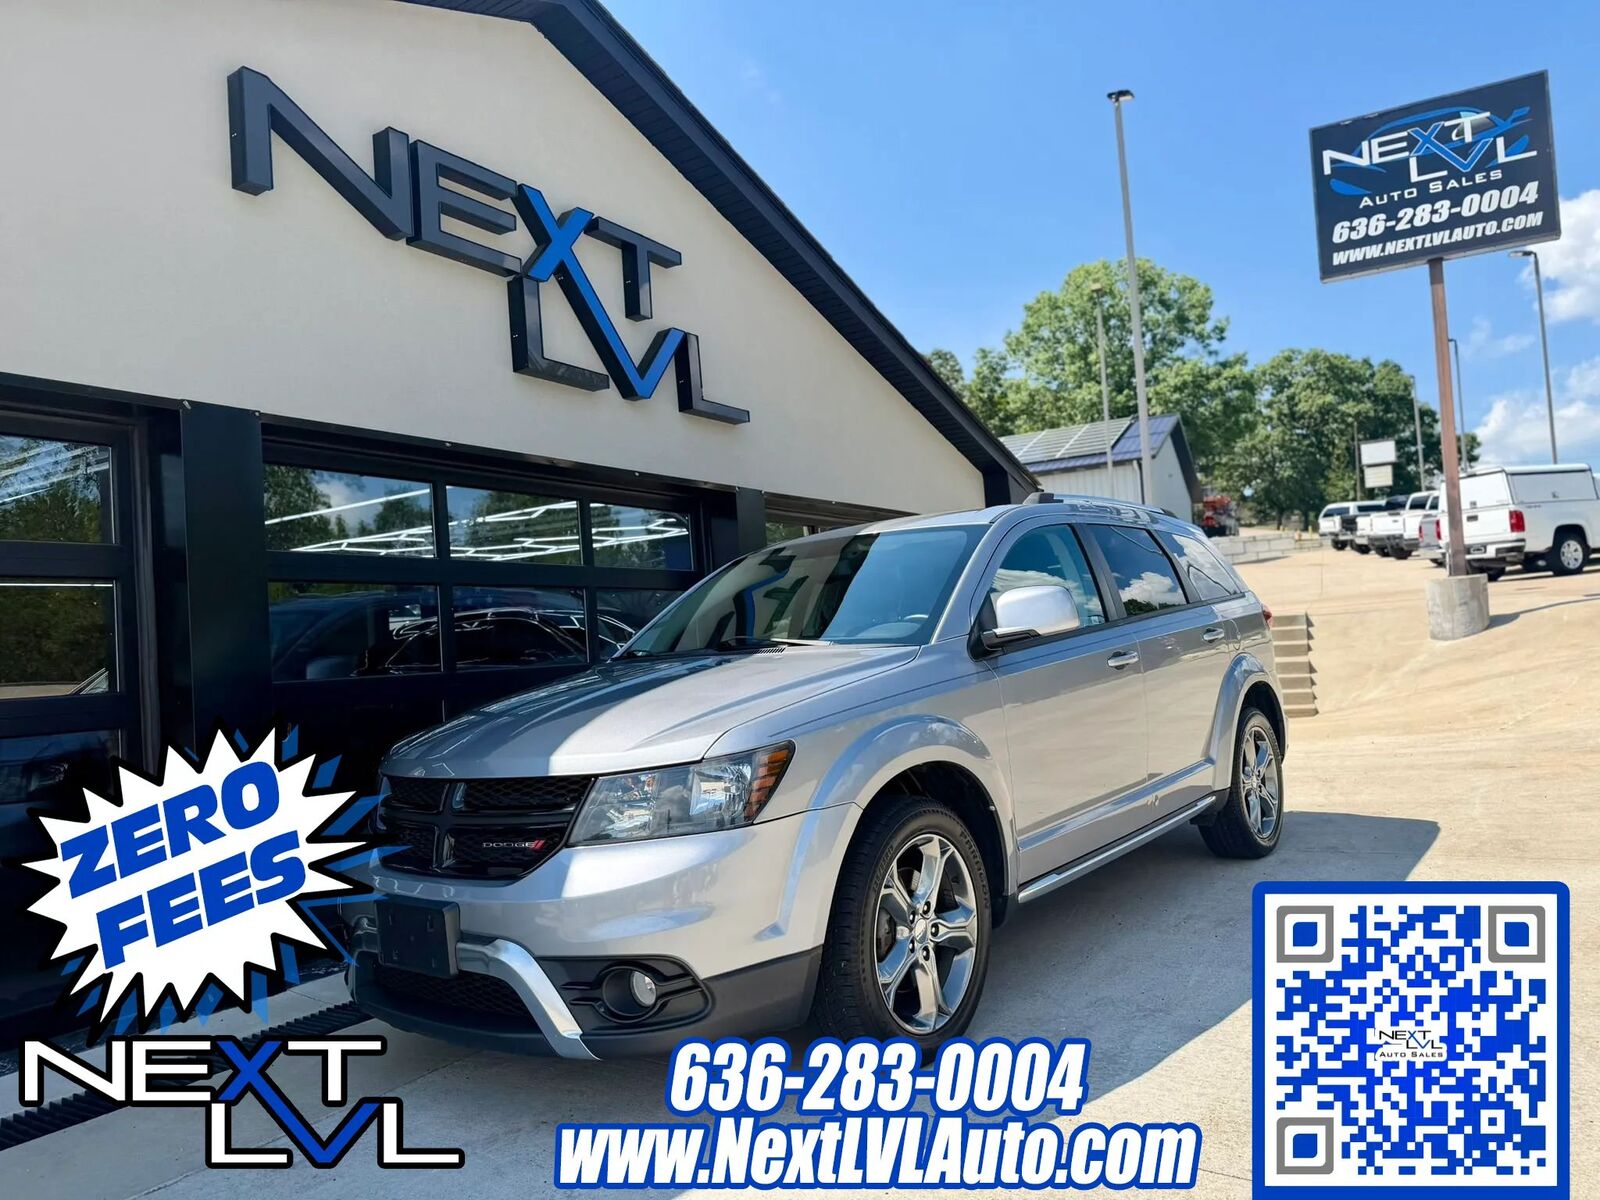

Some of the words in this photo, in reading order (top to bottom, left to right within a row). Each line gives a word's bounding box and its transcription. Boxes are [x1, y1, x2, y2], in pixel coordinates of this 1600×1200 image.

[1321, 111, 1491, 175] NEXT
[1409, 136, 1537, 183] LVL
[227, 65, 682, 321] NEXT
[1332, 181, 1539, 244] 636-283-0004
[1359, 188, 1418, 209] AUTO
[1429, 169, 1503, 193] SALES
[1332, 211, 1544, 266] WWW.NEXTLVLAUTO.COM
[507, 275, 750, 425] LVL
